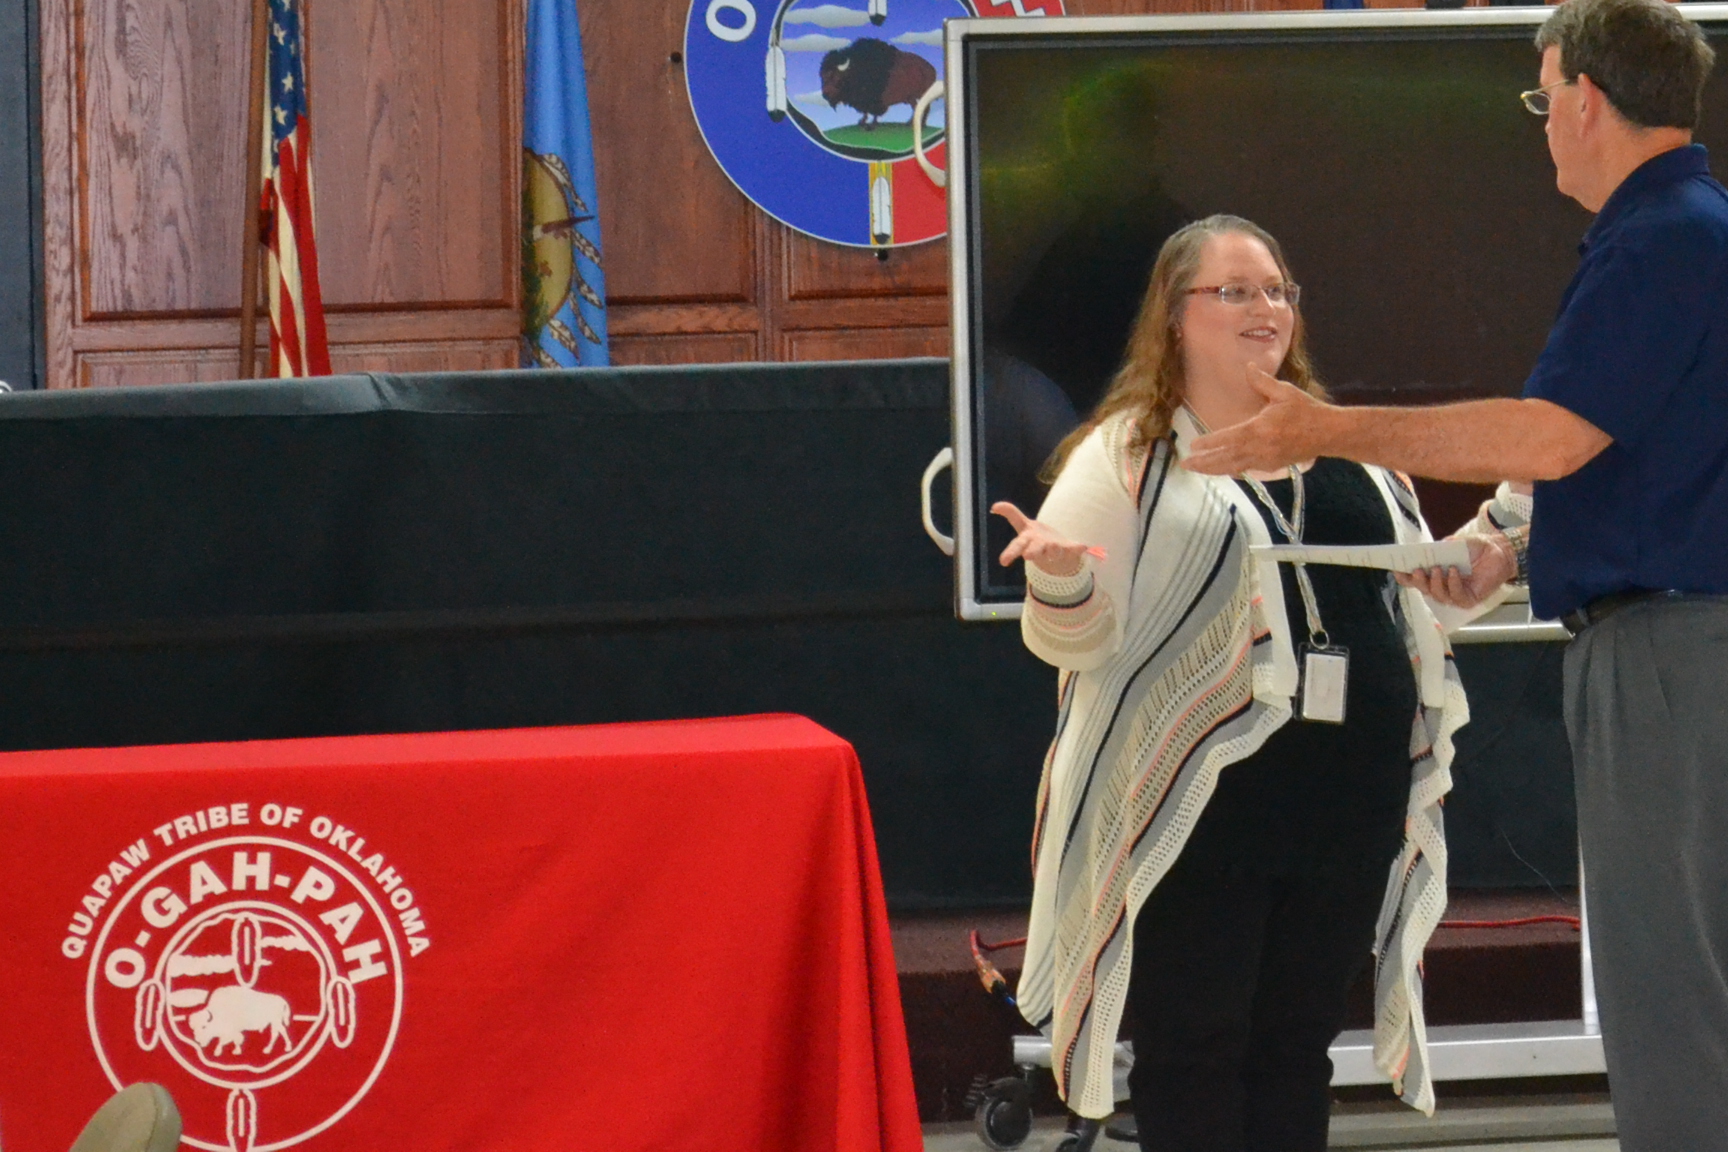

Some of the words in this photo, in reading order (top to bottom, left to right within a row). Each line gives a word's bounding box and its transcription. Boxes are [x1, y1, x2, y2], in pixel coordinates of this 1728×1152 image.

[61, 838, 150, 959] QUAPAW
[153, 803, 250, 846] TRIBE
[260, 803, 303, 828] OF
[309, 816, 430, 958] OKLAHOMA
[104, 851, 388, 988] O-GAH-PAH
